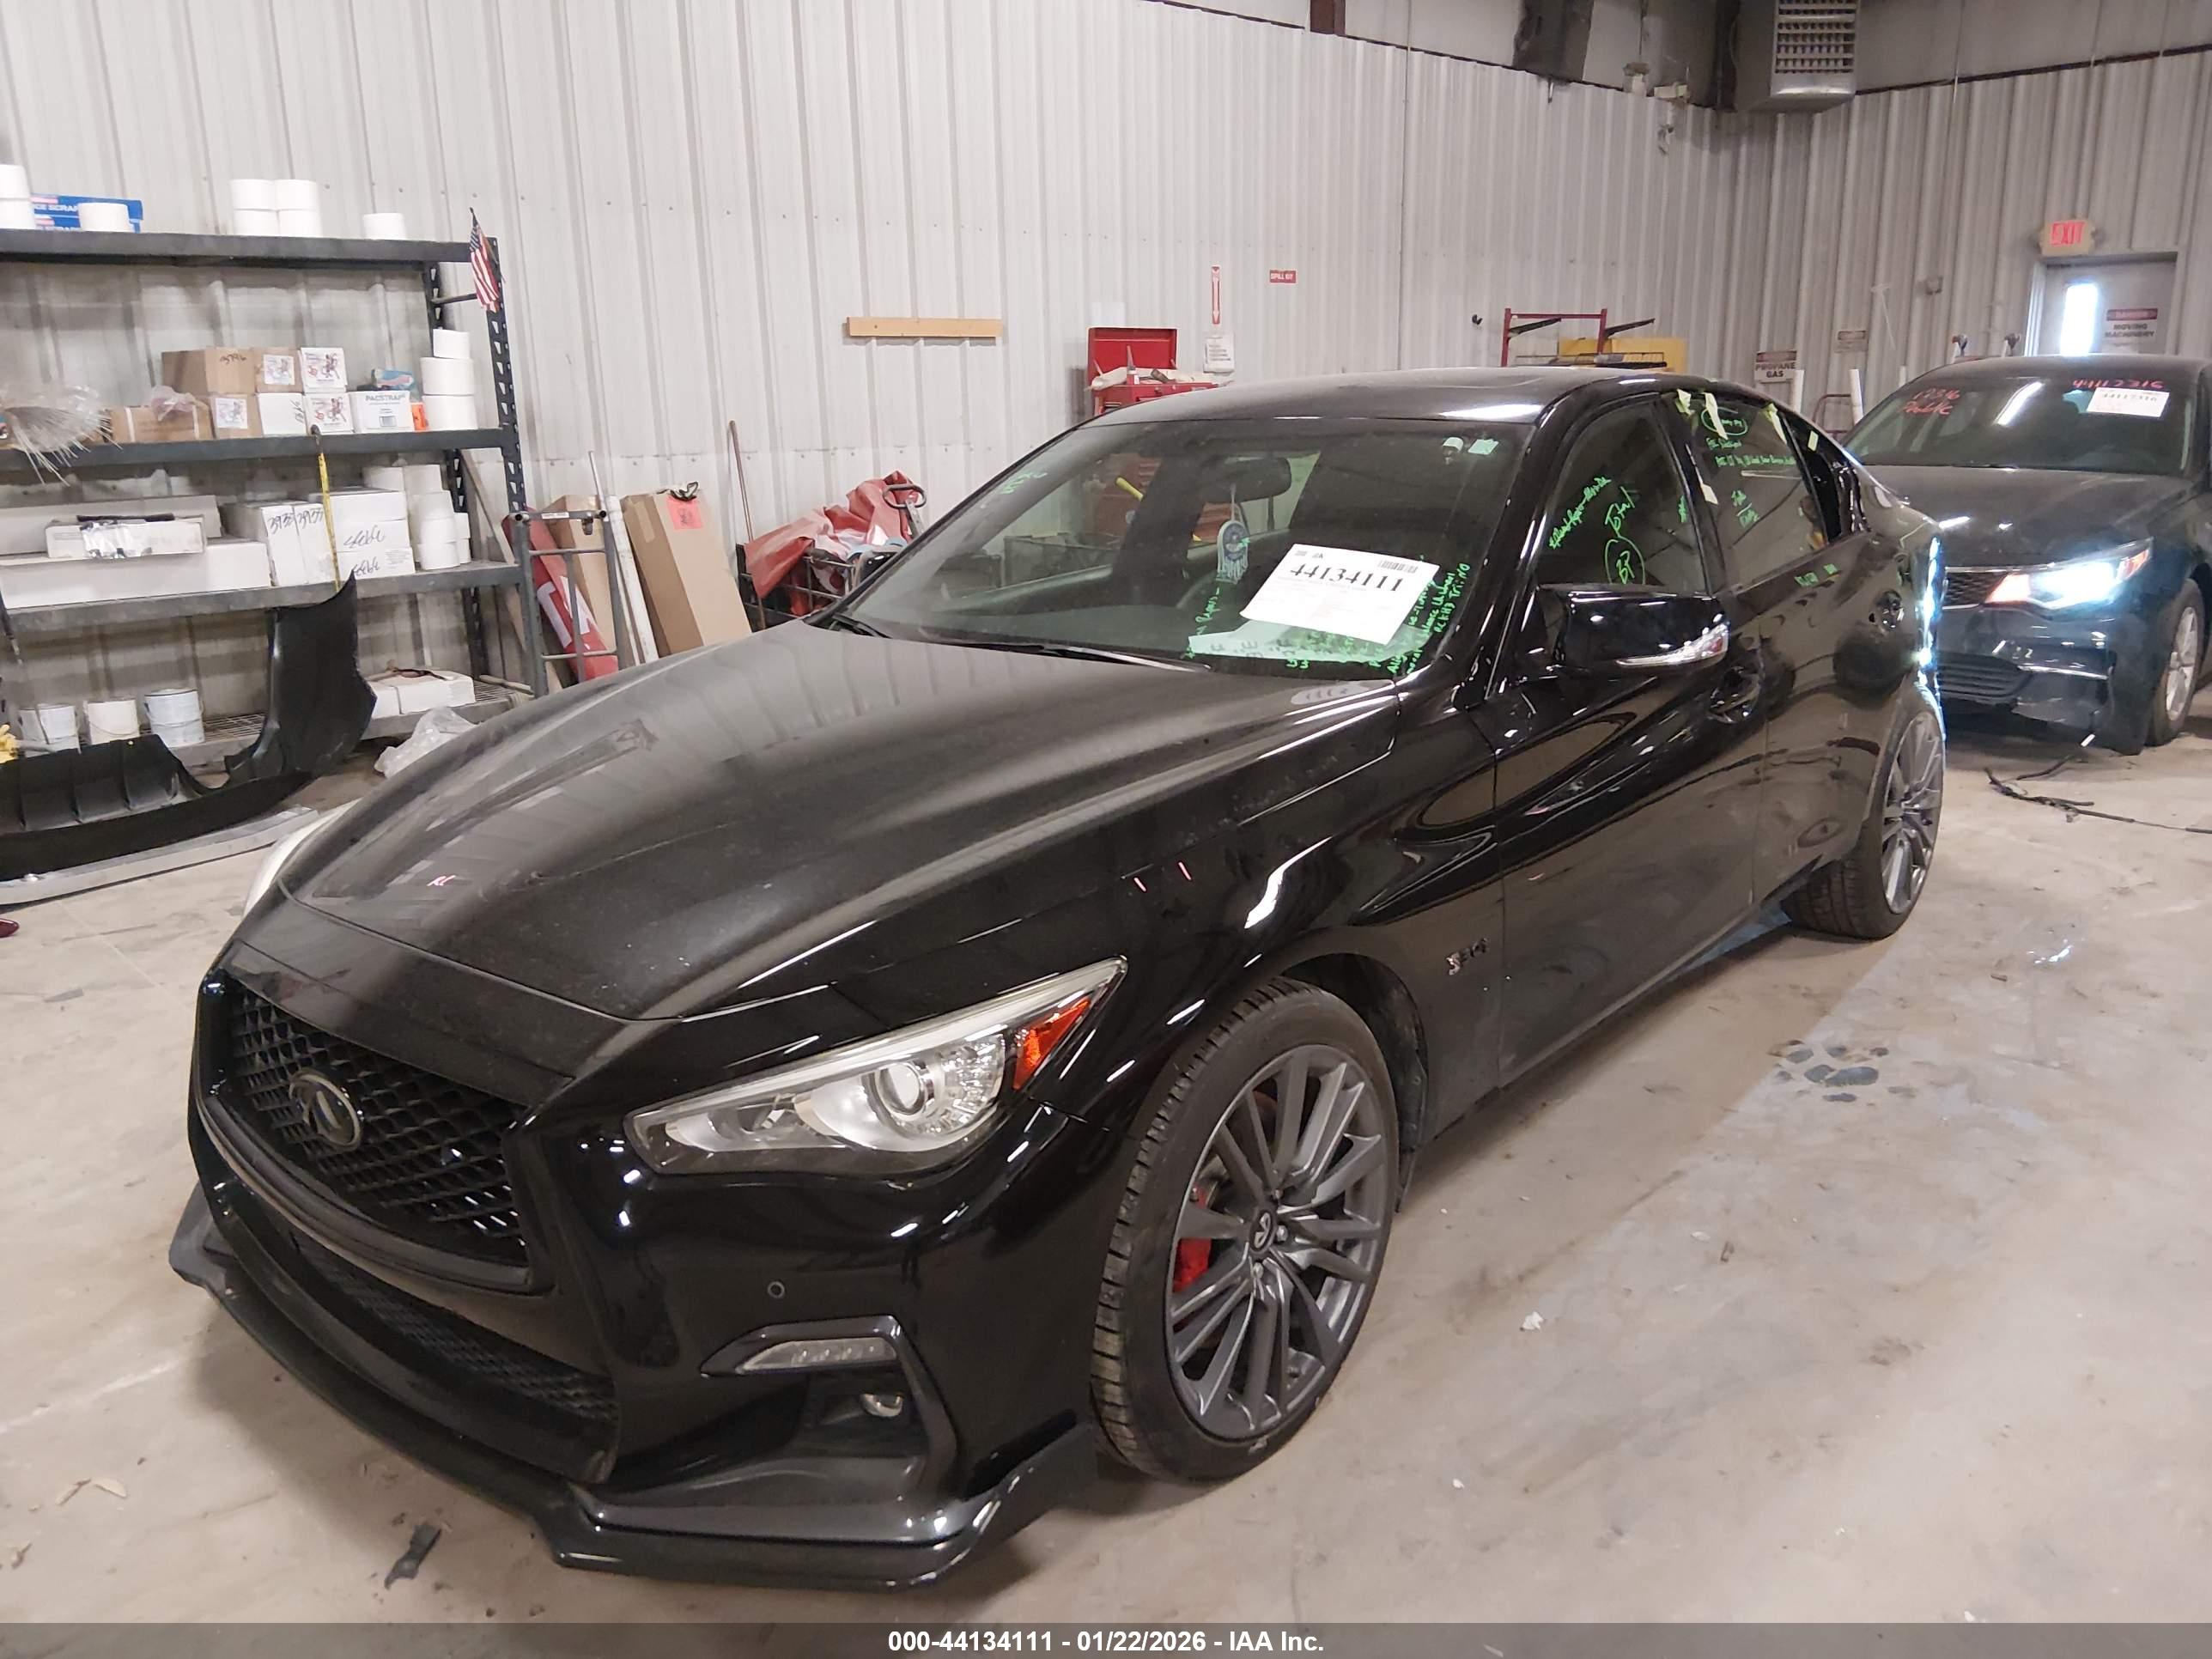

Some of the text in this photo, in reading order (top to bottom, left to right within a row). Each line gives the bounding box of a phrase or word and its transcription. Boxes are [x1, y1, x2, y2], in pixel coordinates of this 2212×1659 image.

[2051, 220, 2085, 246] EXIT
[1755, 362, 1796, 371] PROPANE
[1290, 563, 1403, 592] 44134111
